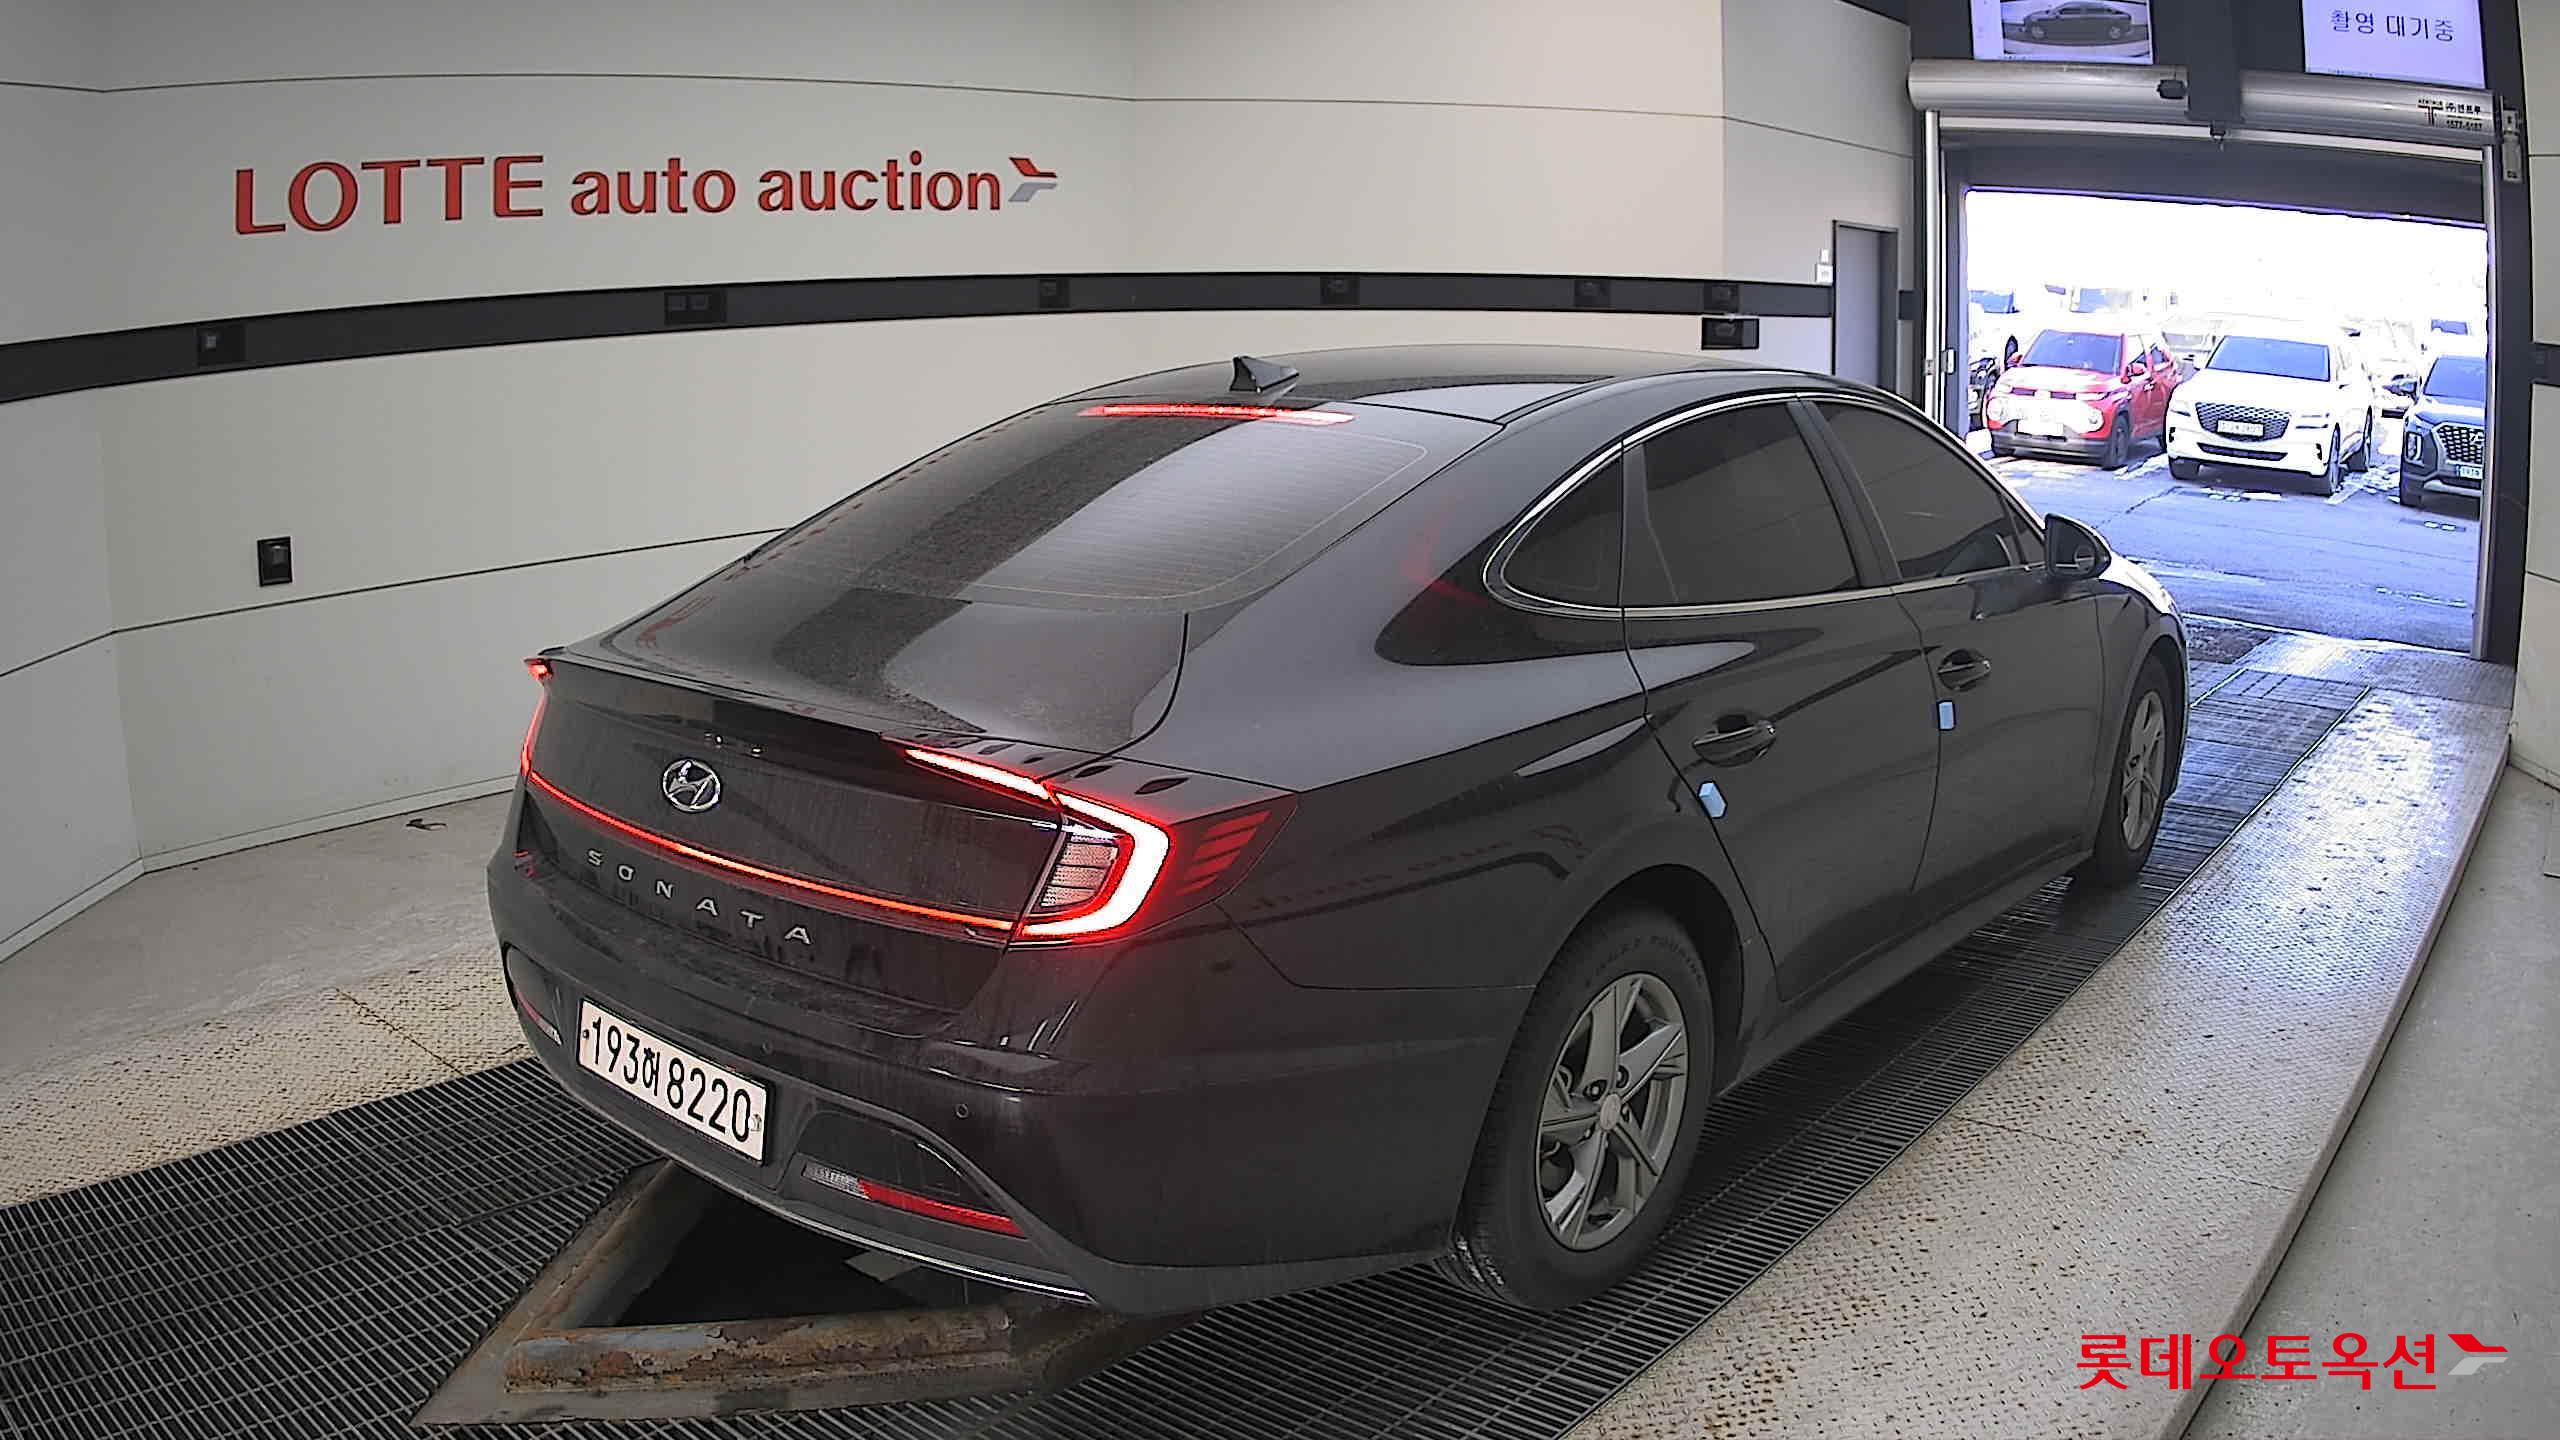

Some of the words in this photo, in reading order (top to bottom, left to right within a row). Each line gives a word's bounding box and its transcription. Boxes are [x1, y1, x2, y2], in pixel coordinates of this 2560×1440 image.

[2331, 9, 2375, 35] 촬영
[2386, 15, 2454, 42] 대기중
[235, 155, 544, 234] LOTTE
[572, 159, 738, 214] auto
[760, 151, 1001, 210] auction
[587, 849, 812, 945] SONATA
